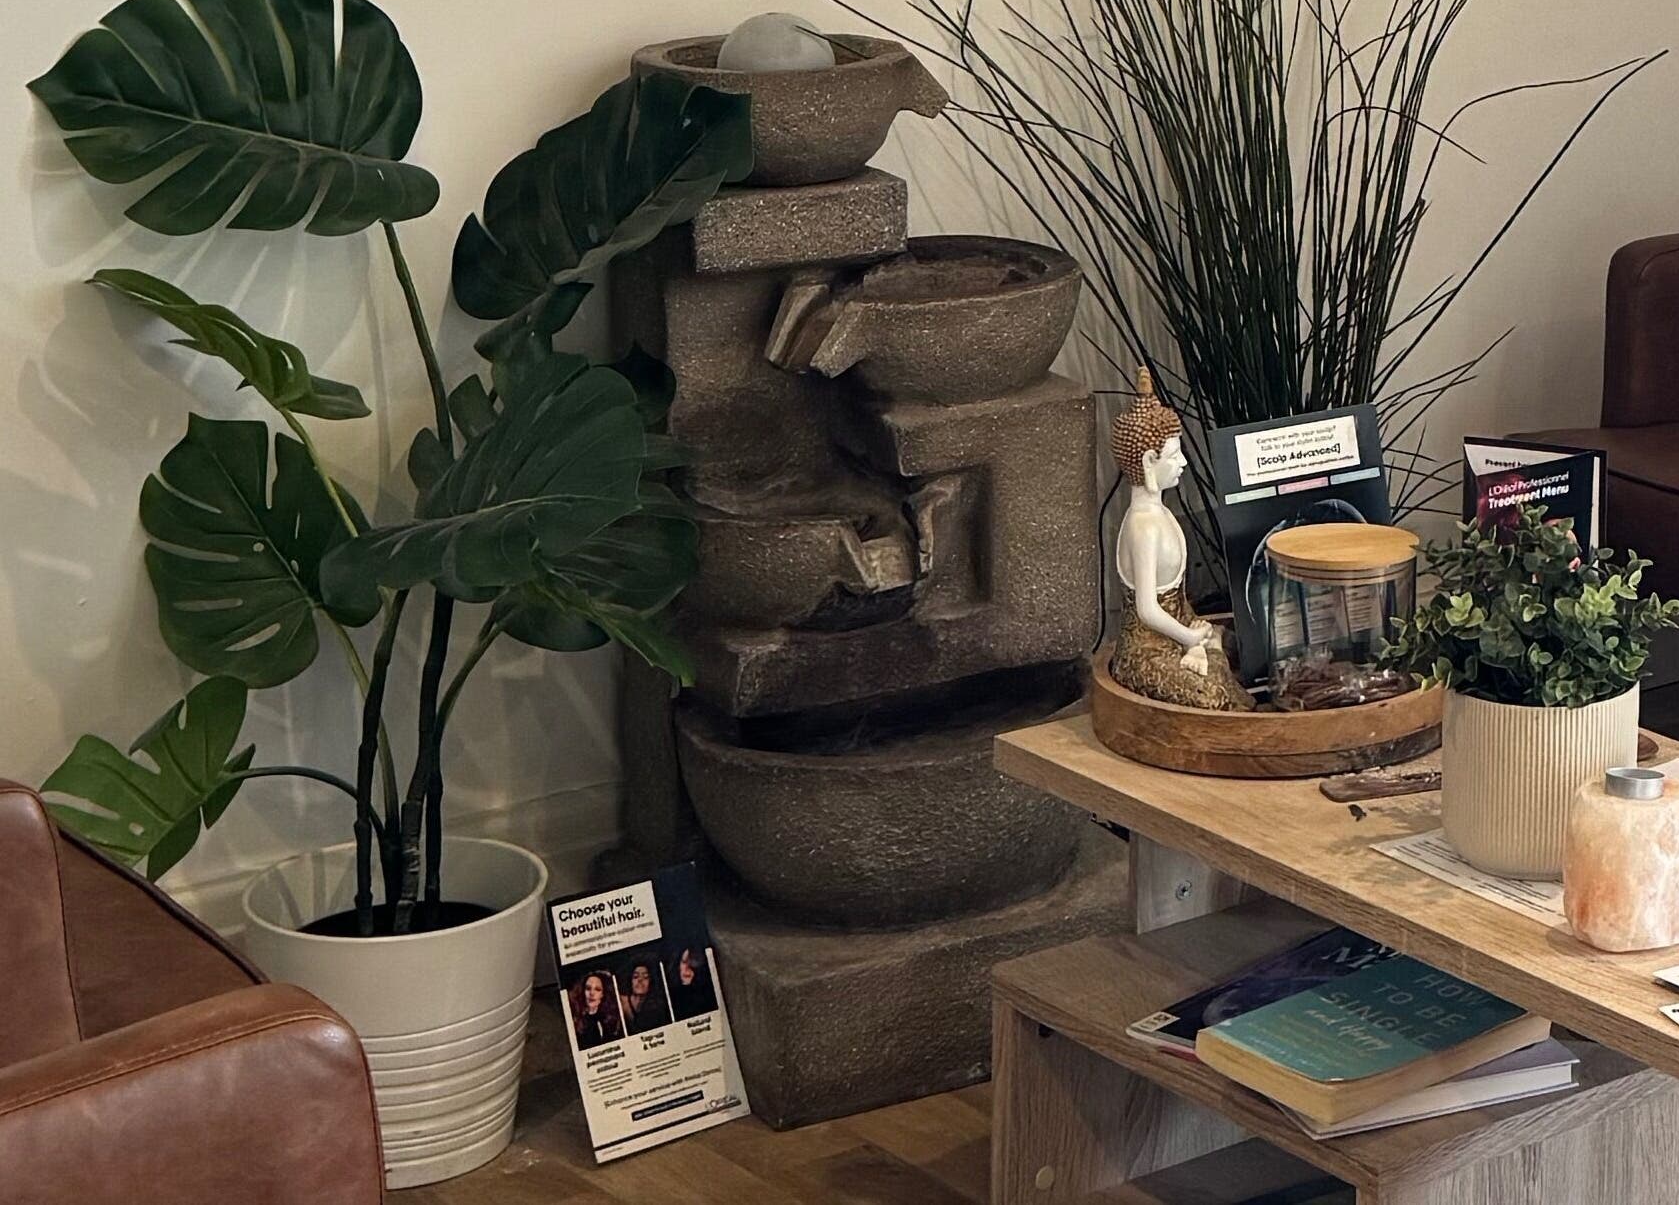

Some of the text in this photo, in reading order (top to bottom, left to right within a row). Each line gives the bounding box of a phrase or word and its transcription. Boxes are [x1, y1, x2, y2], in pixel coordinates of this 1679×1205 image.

[1488, 484, 1570, 509] Treatment Menu
[559, 895, 633, 922] Choose your
[561, 913, 616, 938] beautiful
[617, 907, 645, 922] hair.
[1375, 983, 1467, 1028] TO BE
[1415, 973, 1490, 1006] HOW
[1319, 992, 1442, 1046] SINGLE
